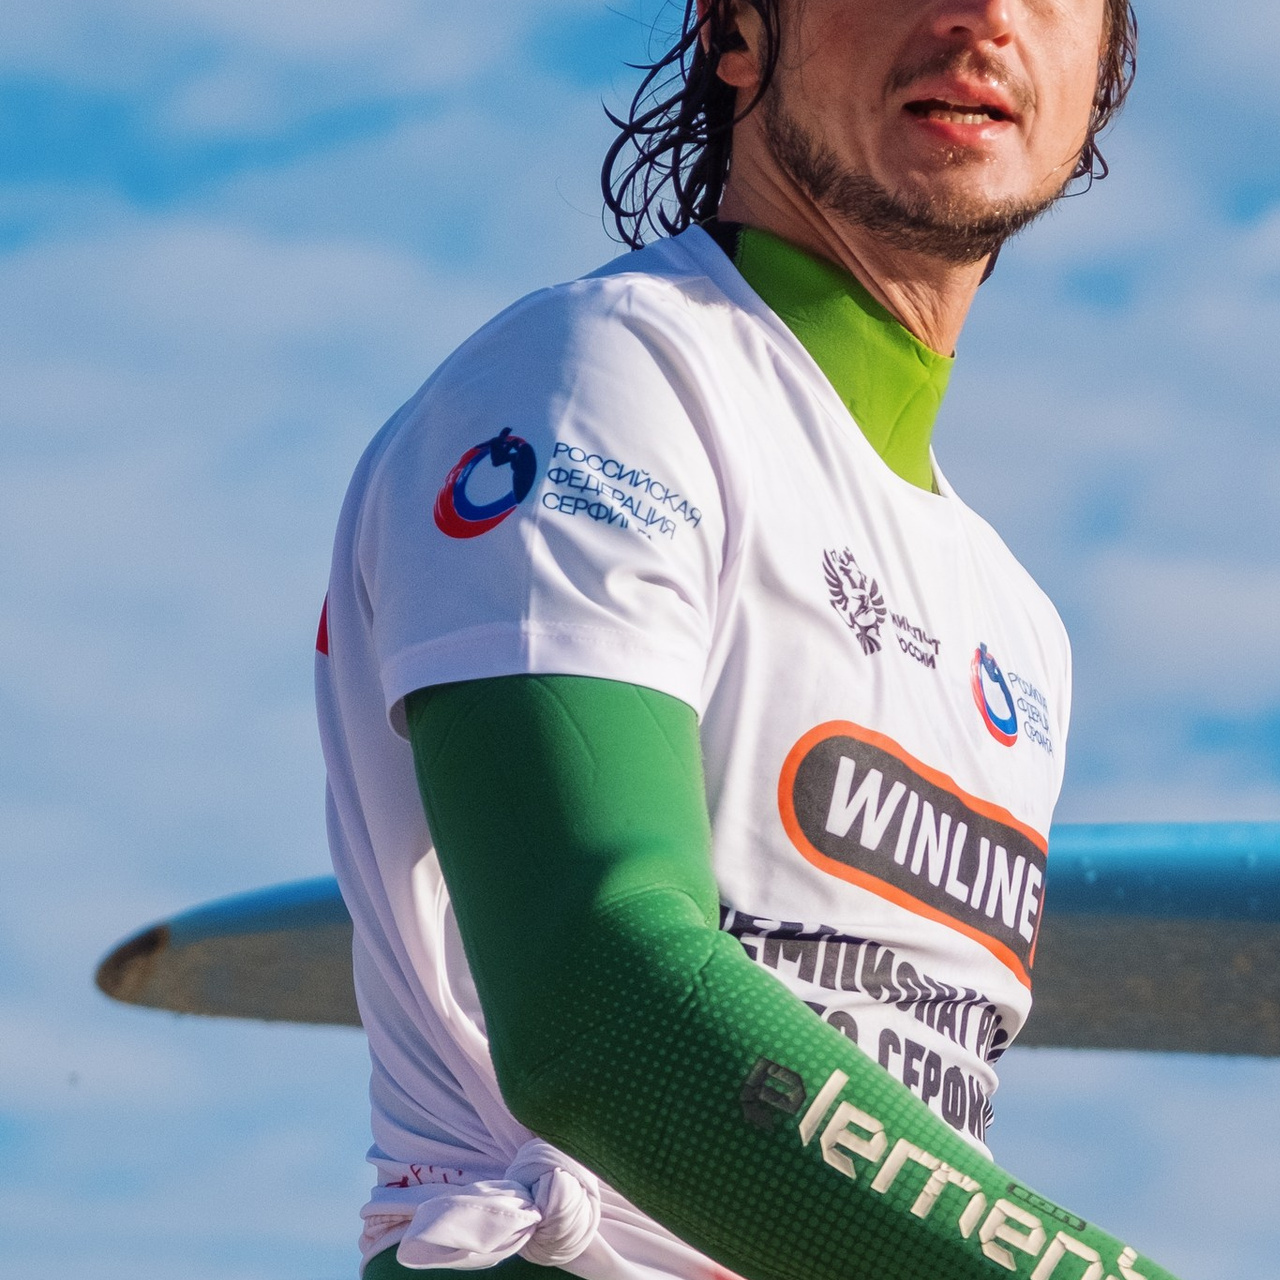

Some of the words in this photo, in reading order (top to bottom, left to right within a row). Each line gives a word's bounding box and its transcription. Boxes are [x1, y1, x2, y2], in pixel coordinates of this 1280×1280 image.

[547, 466, 677, 540] ФЕДЕРАЦИЯ
[553, 441, 703, 528] РОССИЙСКАЯ
[826, 755, 1044, 944] WINLINE
